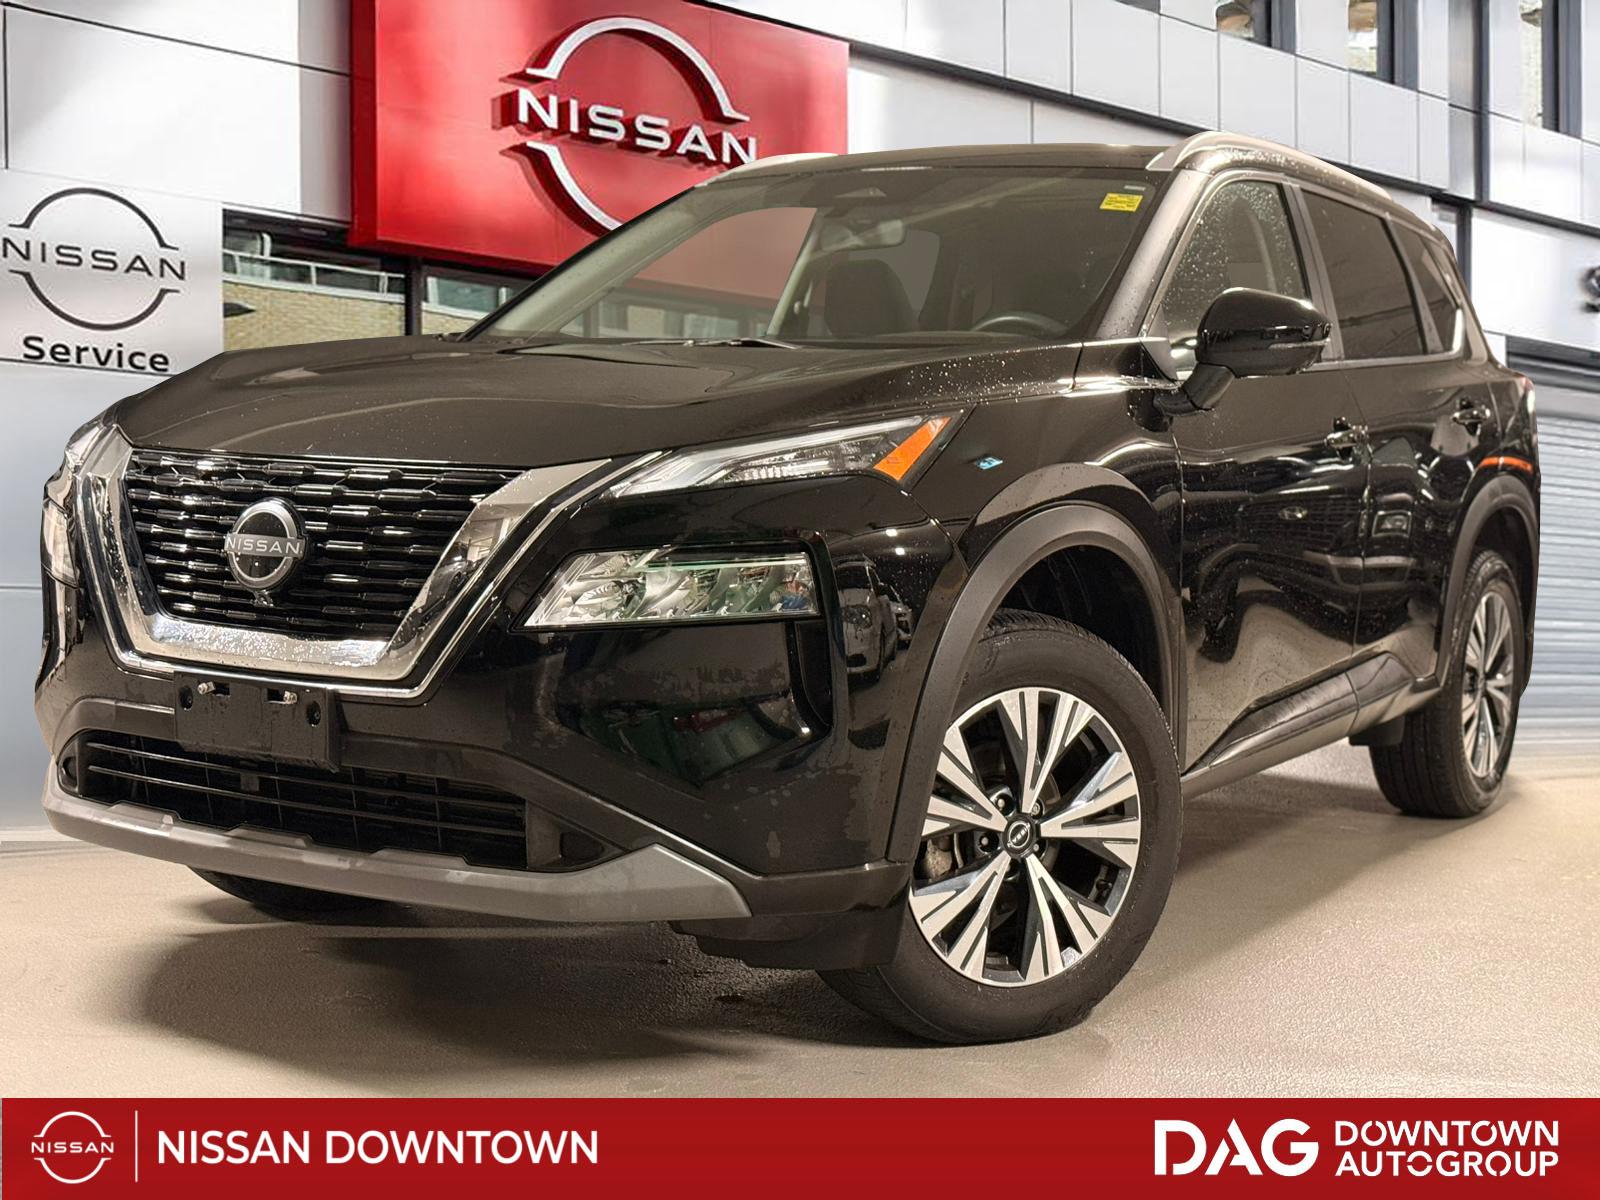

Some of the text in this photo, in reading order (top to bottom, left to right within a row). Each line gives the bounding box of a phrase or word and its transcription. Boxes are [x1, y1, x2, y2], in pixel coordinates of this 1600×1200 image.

[517, 87, 757, 165] NISSAN
[2, 237, 186, 281] NISSAN
[22, 335, 170, 373] Service
[225, 537, 300, 555] NISSAN
